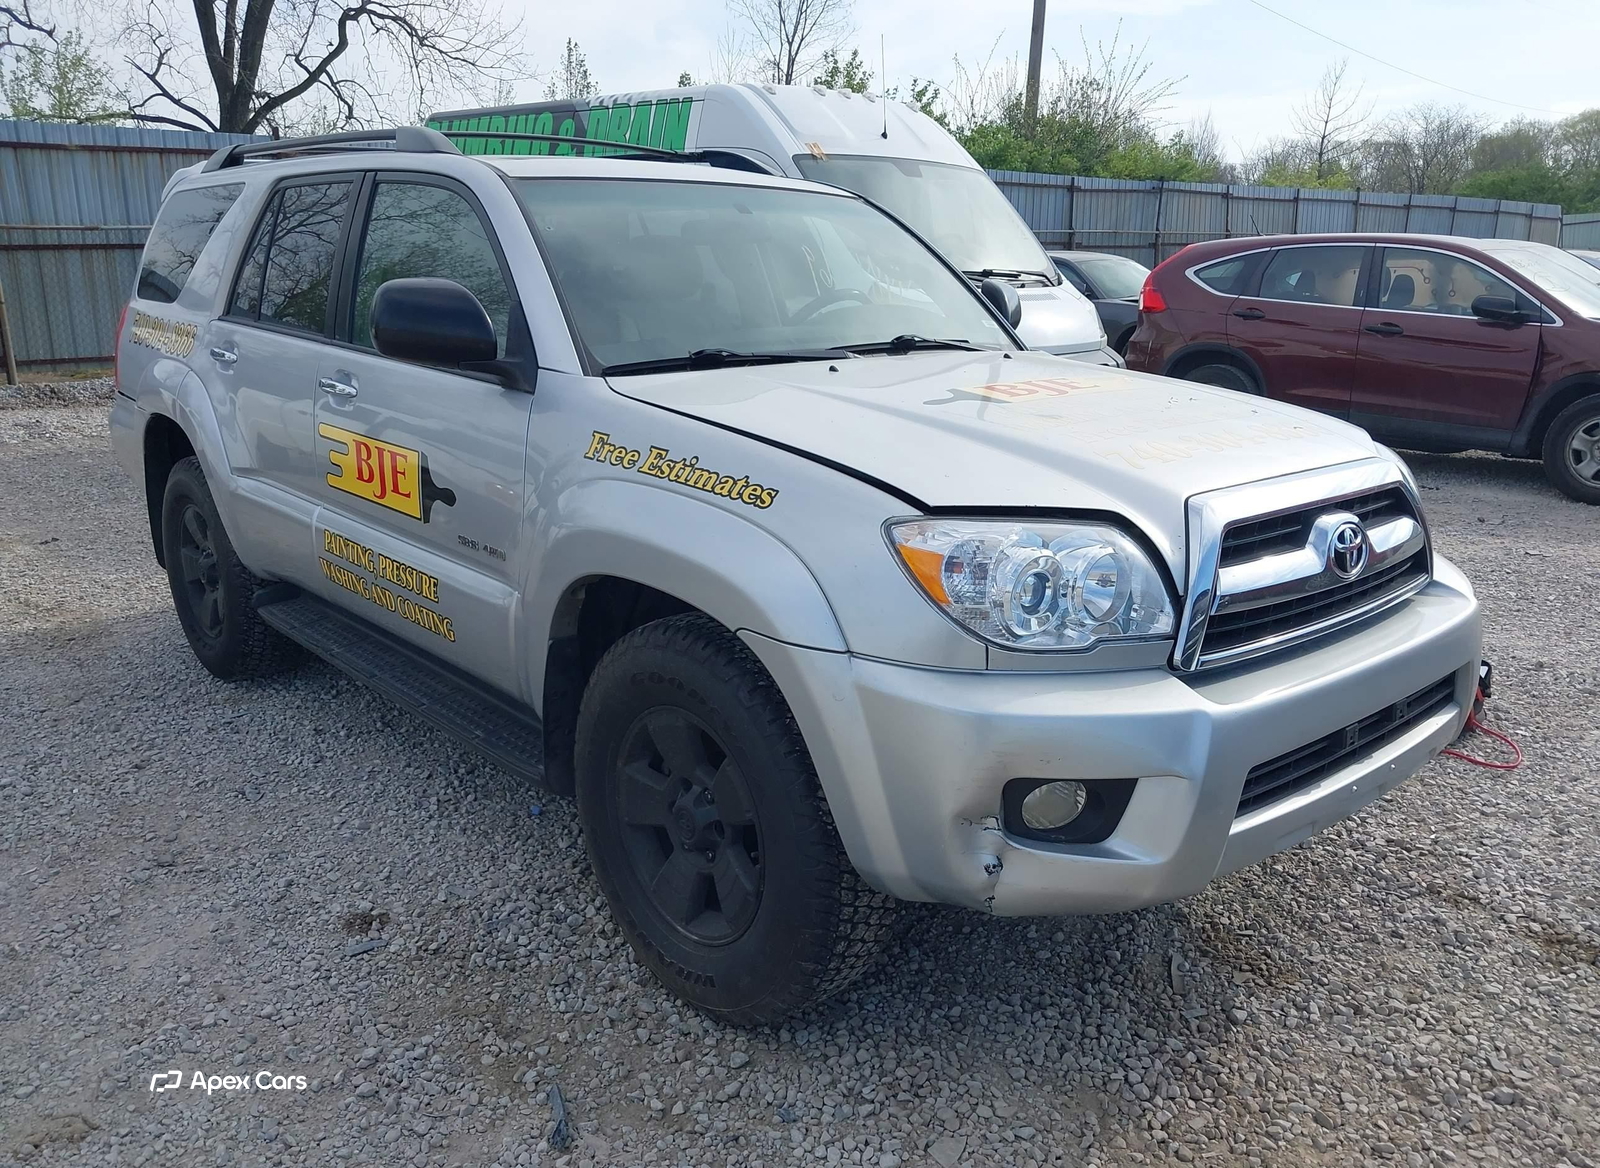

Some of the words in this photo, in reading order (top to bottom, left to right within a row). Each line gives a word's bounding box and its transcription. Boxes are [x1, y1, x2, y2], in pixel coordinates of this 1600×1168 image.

[428, 112, 554, 155] UMBING
[583, 97, 693, 157] DRAIN
[974, 377, 1101, 398] BJE
[352, 438, 412, 500] BJE
[584, 430, 640, 469] Free
[637, 445, 779, 509] Estimates
[319, 557, 370, 600] WASHING
[371, 581, 396, 613] AND
[396, 594, 456, 643] COATING
[323, 529, 378, 580] PAINTING,
[378, 553, 439, 604] PRESSURE
